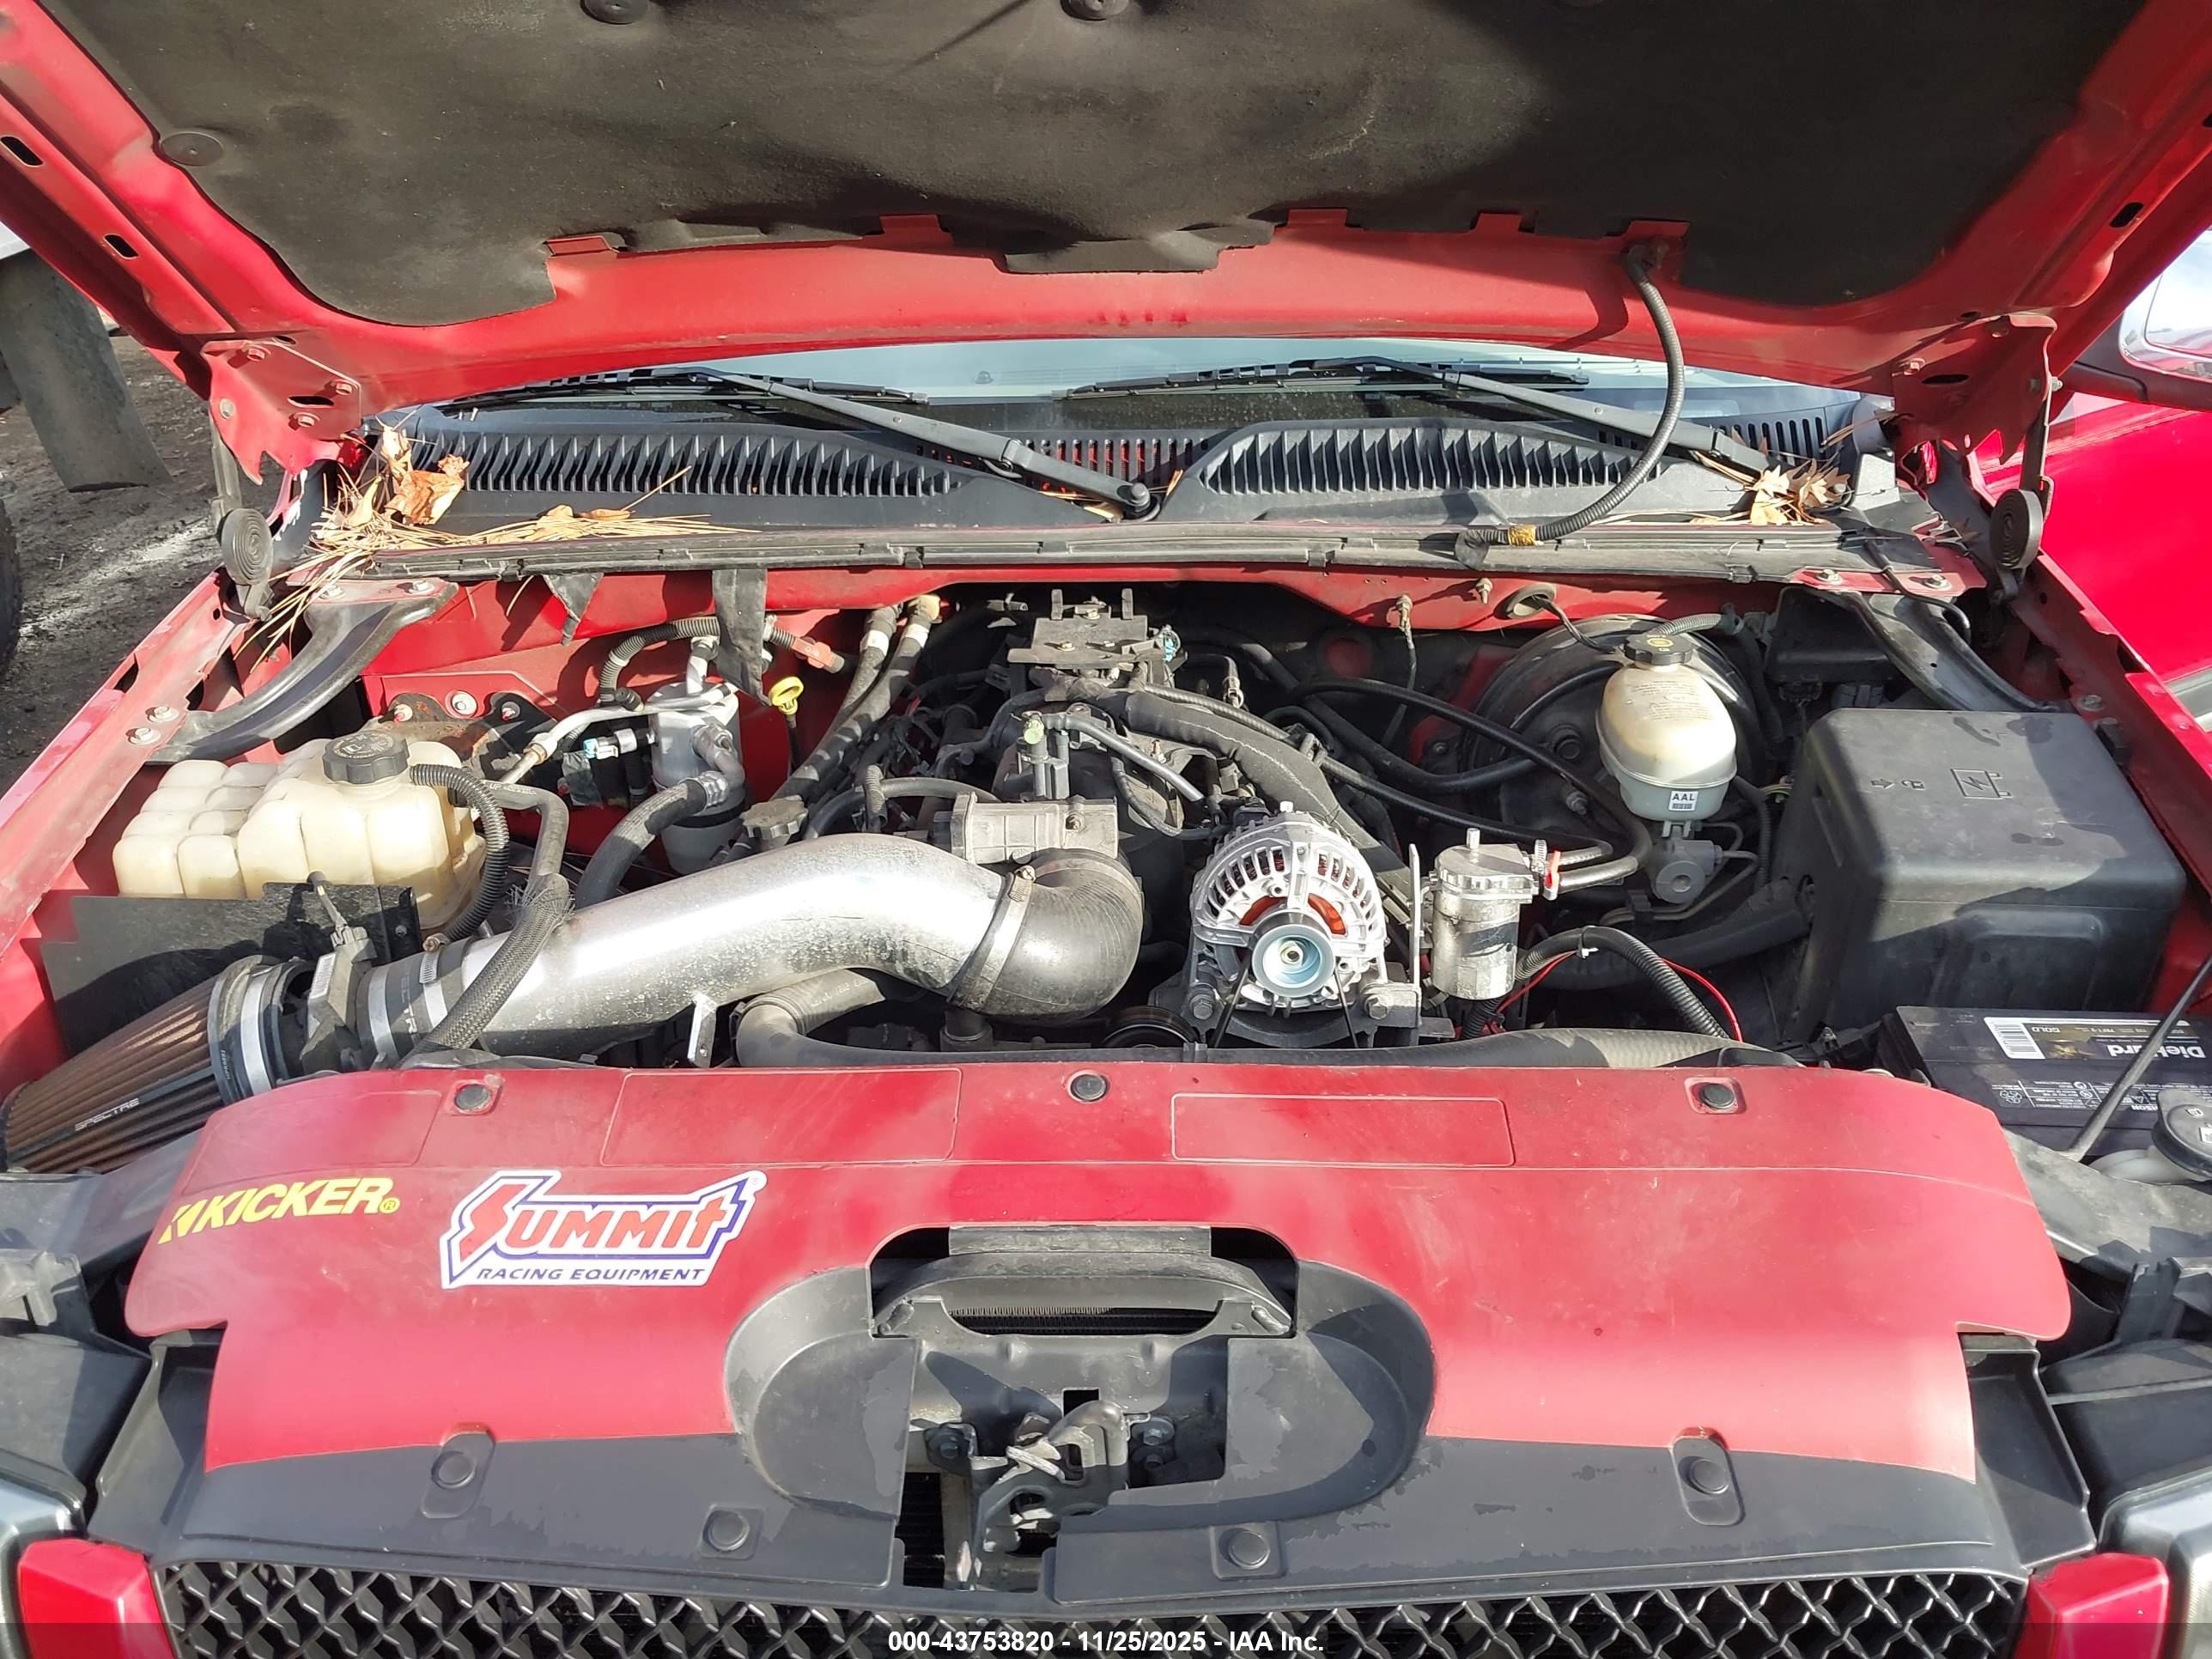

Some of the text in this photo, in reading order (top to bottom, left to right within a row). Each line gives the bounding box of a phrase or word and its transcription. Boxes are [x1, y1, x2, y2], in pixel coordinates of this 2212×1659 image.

[1671, 793, 1695, 801] AAL
[75, 1097, 140, 1132] SPECTRE
[477, 1268, 706, 1280] RACING EQUIPMENT
